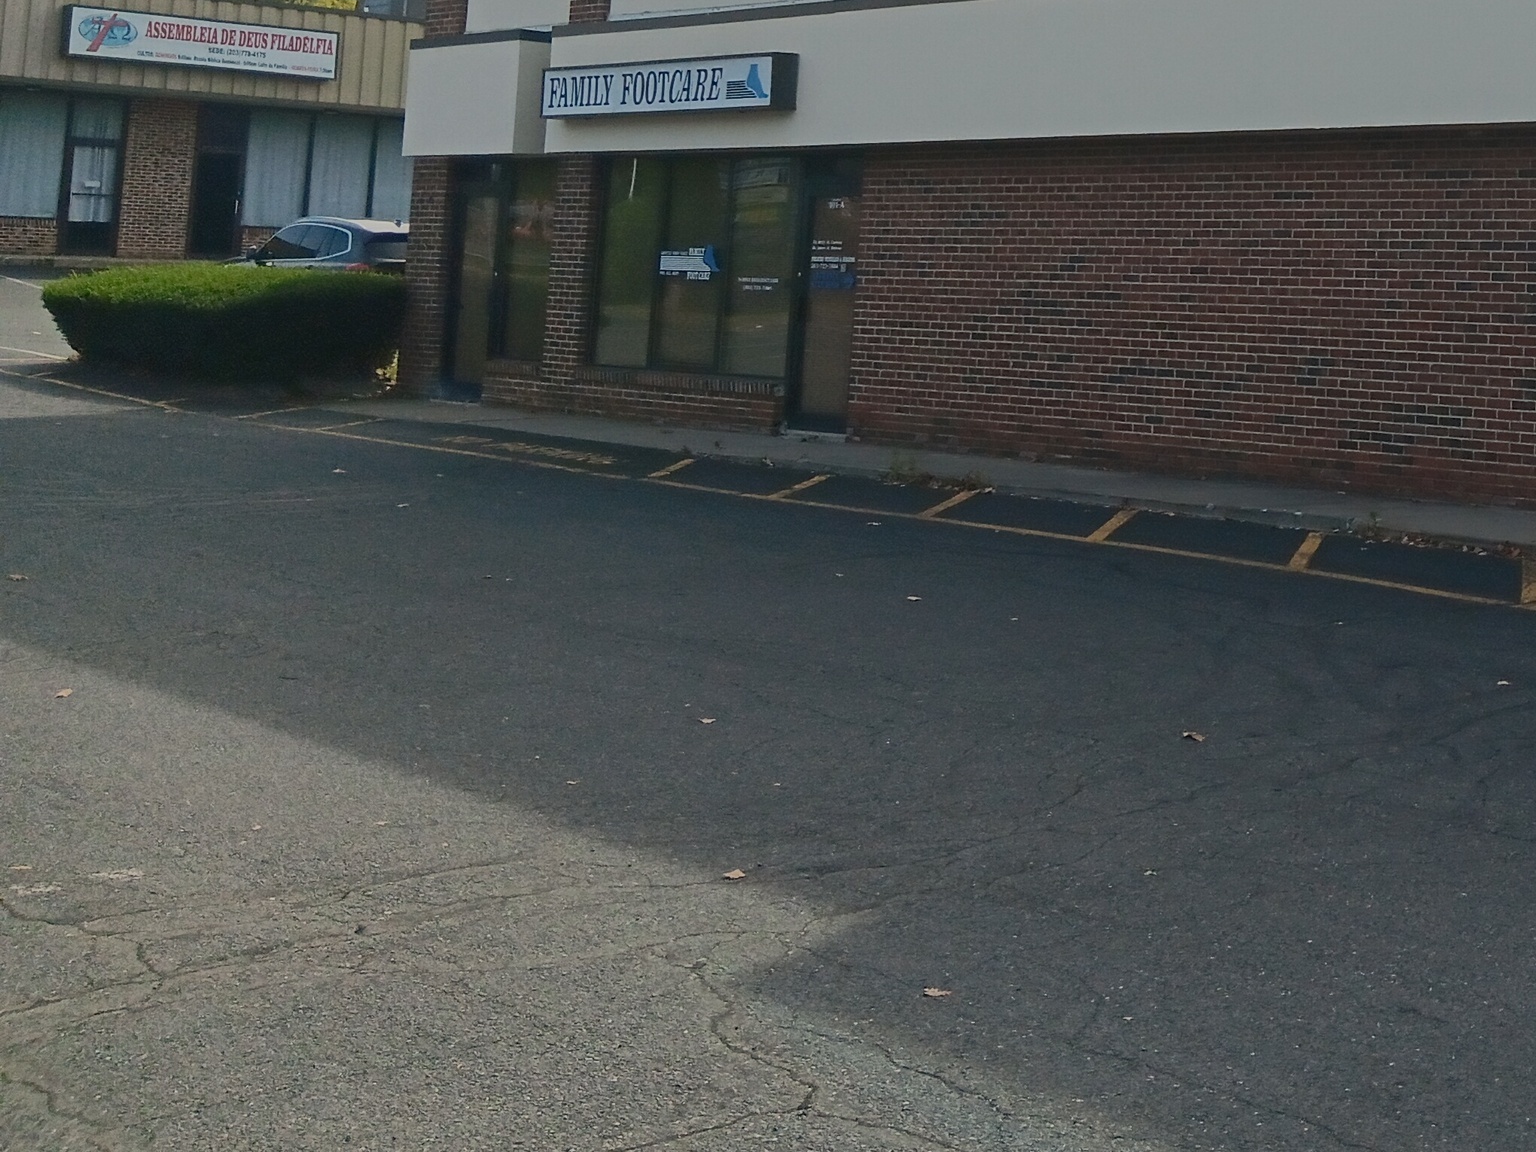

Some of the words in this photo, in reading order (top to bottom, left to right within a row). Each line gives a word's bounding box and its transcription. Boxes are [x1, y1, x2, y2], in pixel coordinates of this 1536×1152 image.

[145, 20, 218, 44] ASSEMBLEIA
[221, 29, 237, 46] DE
[238, 31, 268, 50] DEUS
[548, 74, 614, 109] FAMILY
[620, 67, 723, 106] FOOTCARE
